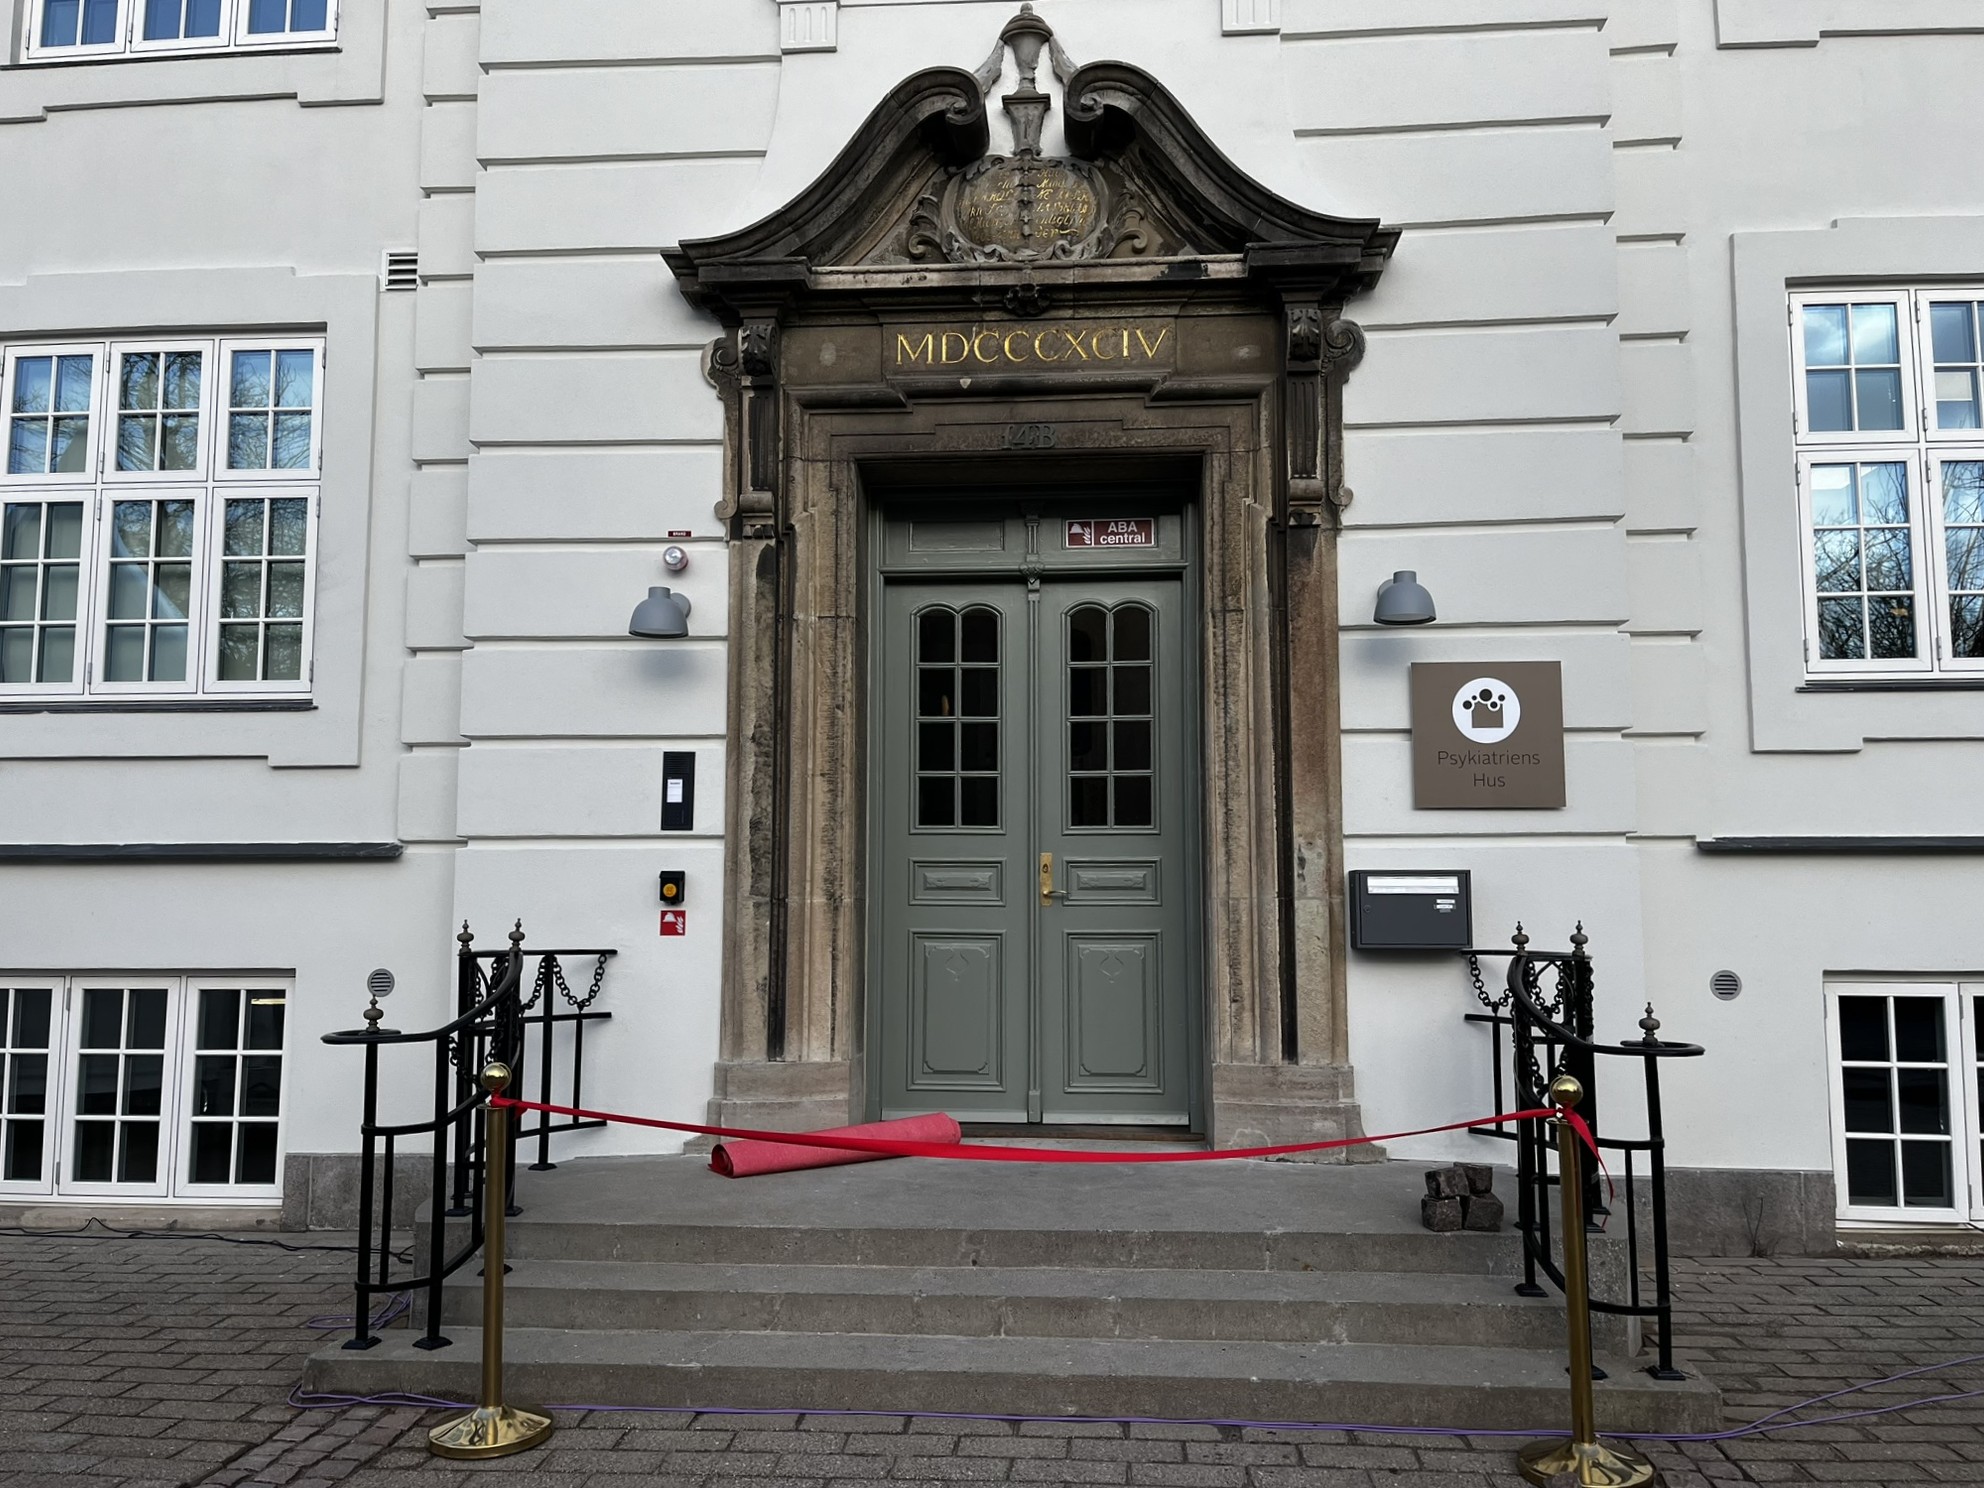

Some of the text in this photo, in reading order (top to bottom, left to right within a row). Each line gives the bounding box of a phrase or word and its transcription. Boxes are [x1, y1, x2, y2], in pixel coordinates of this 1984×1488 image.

[896, 325, 1170, 365] MDCCCXCIV
[1107, 521, 1138, 533] ABA
[1100, 532, 1145, 544] central
[1437, 750, 1541, 769] Psykiatriens
[1473, 773, 1506, 788] Hus
